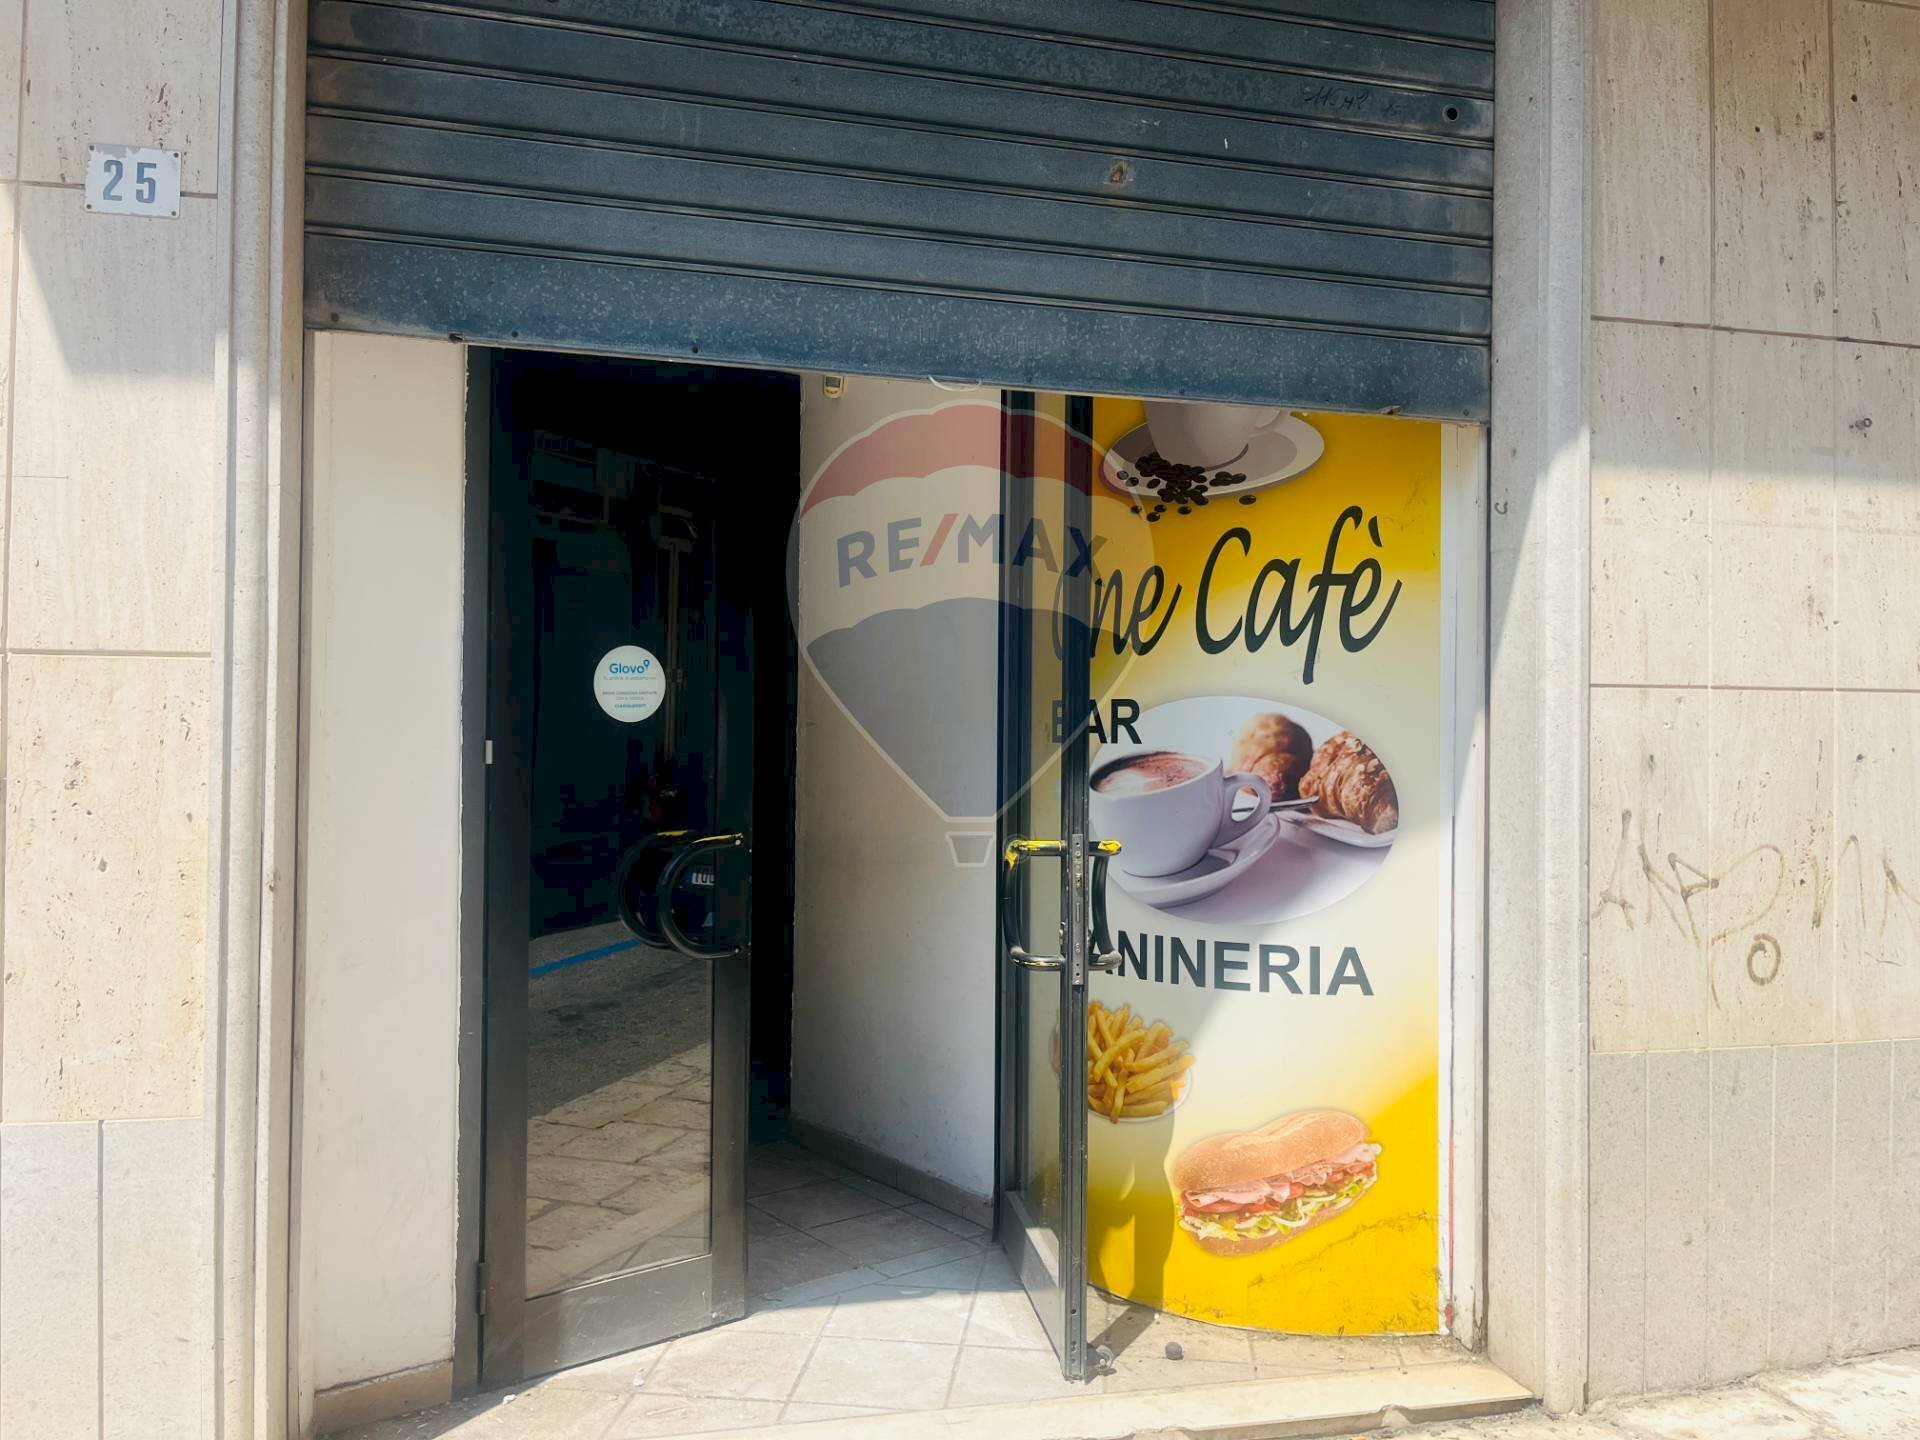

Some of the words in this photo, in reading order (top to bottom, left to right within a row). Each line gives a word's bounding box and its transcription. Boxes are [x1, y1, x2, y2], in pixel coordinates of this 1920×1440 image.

[102, 159, 157, 204] 25
[1195, 505, 1402, 685] Cafè
[608, 662, 646, 674] Glovo
